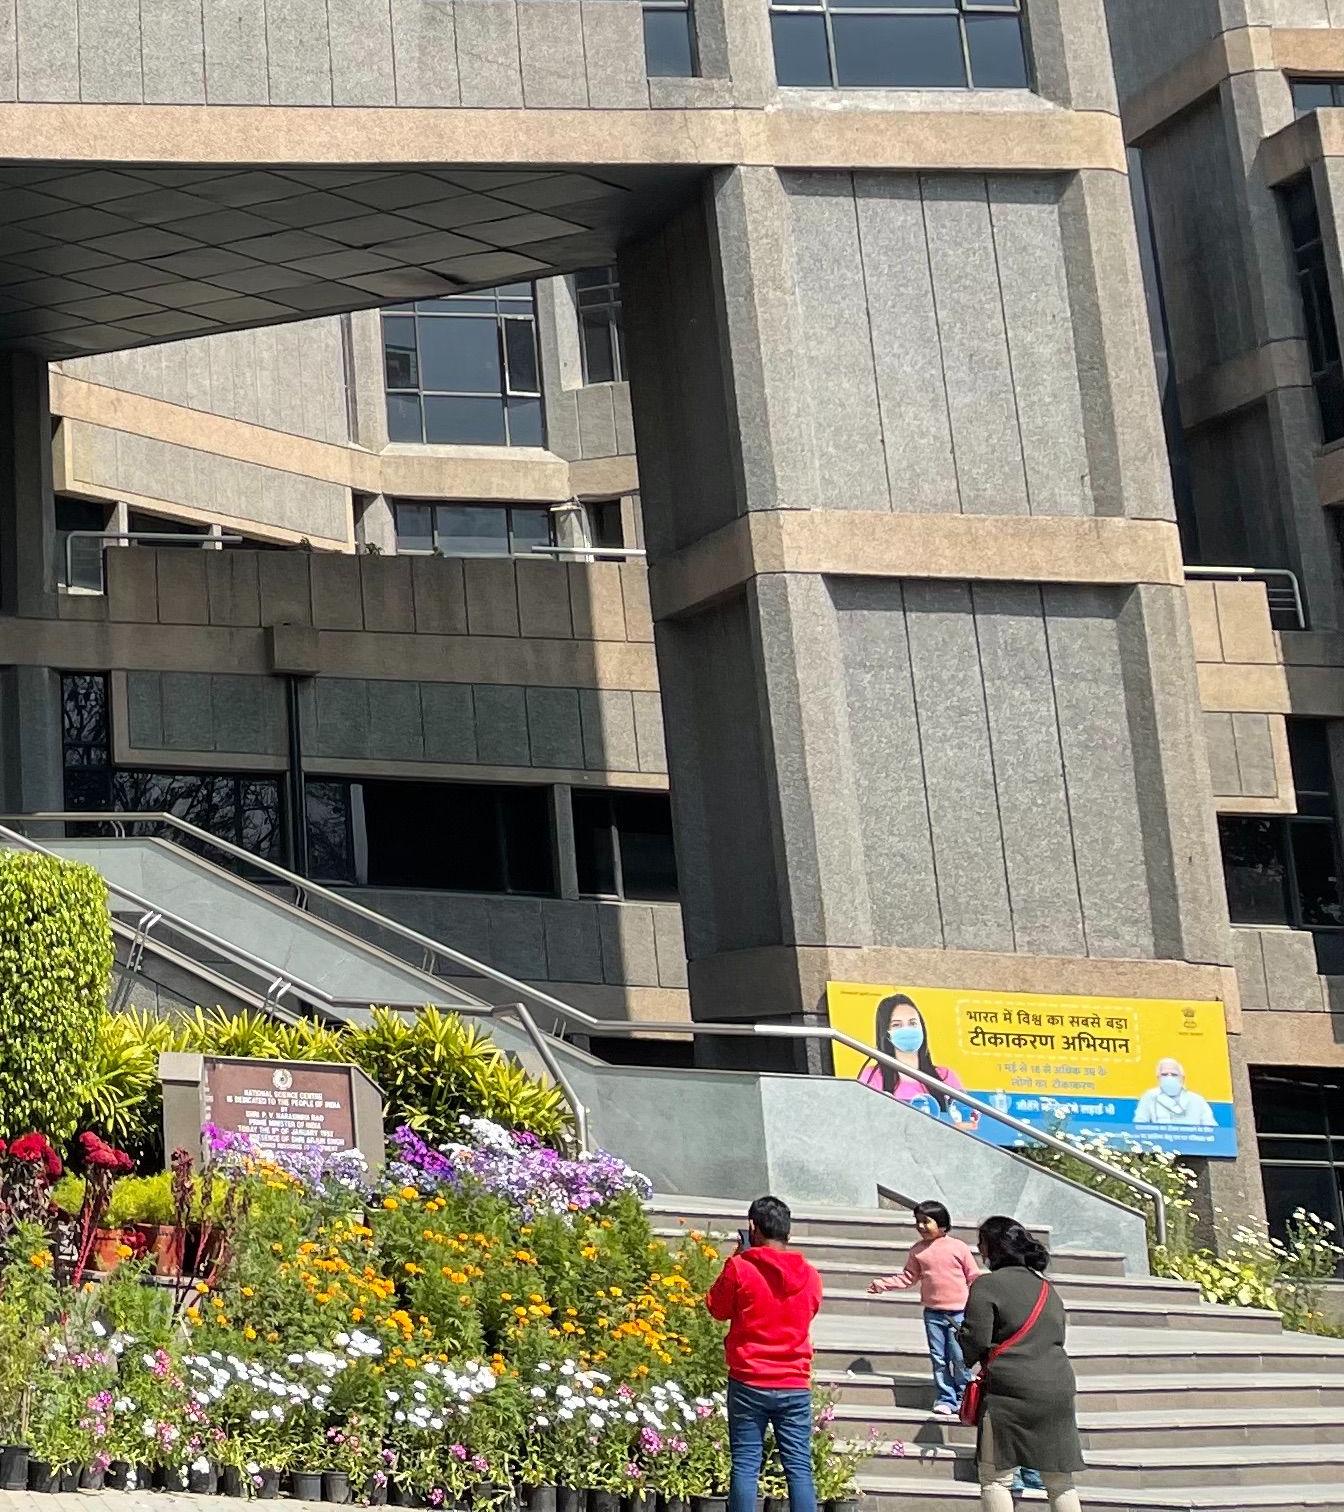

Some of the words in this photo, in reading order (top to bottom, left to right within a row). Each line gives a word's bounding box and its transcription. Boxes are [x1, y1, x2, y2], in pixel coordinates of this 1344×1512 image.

[966, 1010, 998, 1024] भारत
[1003, 1008, 1013, 1025] में
[1016, 1009, 1042, 1027] विश्व
[1047, 1014, 1064, 1027] का
[1069, 1013, 1101, 1028] सबसे
[1106, 1017, 1128, 1033] बड़ा
[968, 1025, 1055, 1050] टीकाकरण
[1062, 1031, 1130, 1054] अभियान
